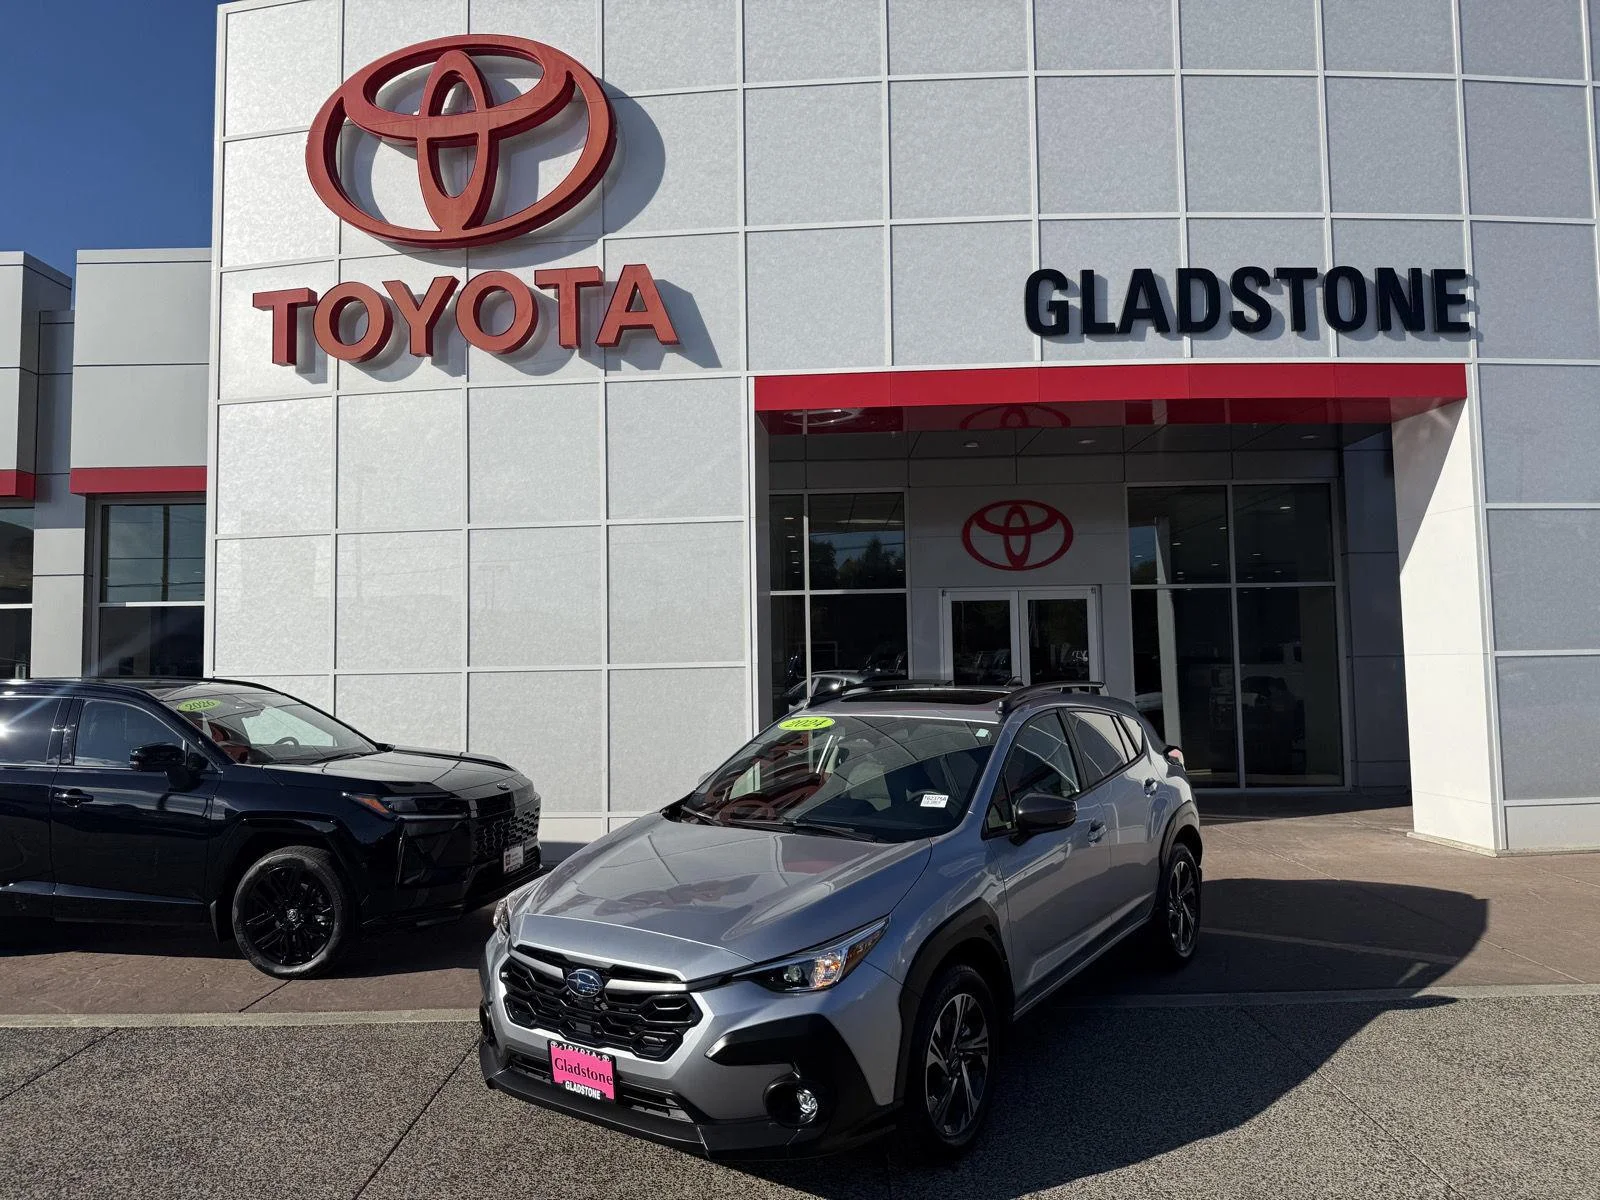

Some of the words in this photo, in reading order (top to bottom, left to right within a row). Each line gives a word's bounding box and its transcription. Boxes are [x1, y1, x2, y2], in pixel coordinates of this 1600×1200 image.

[252, 263, 680, 367] TOYOTA
[1024, 266, 1470, 337] GLADSTONE
[185, 700, 216, 711] 2026
[554, 1057, 613, 1086] Gladstone
[565, 1080, 601, 1100] GLADSTONE
